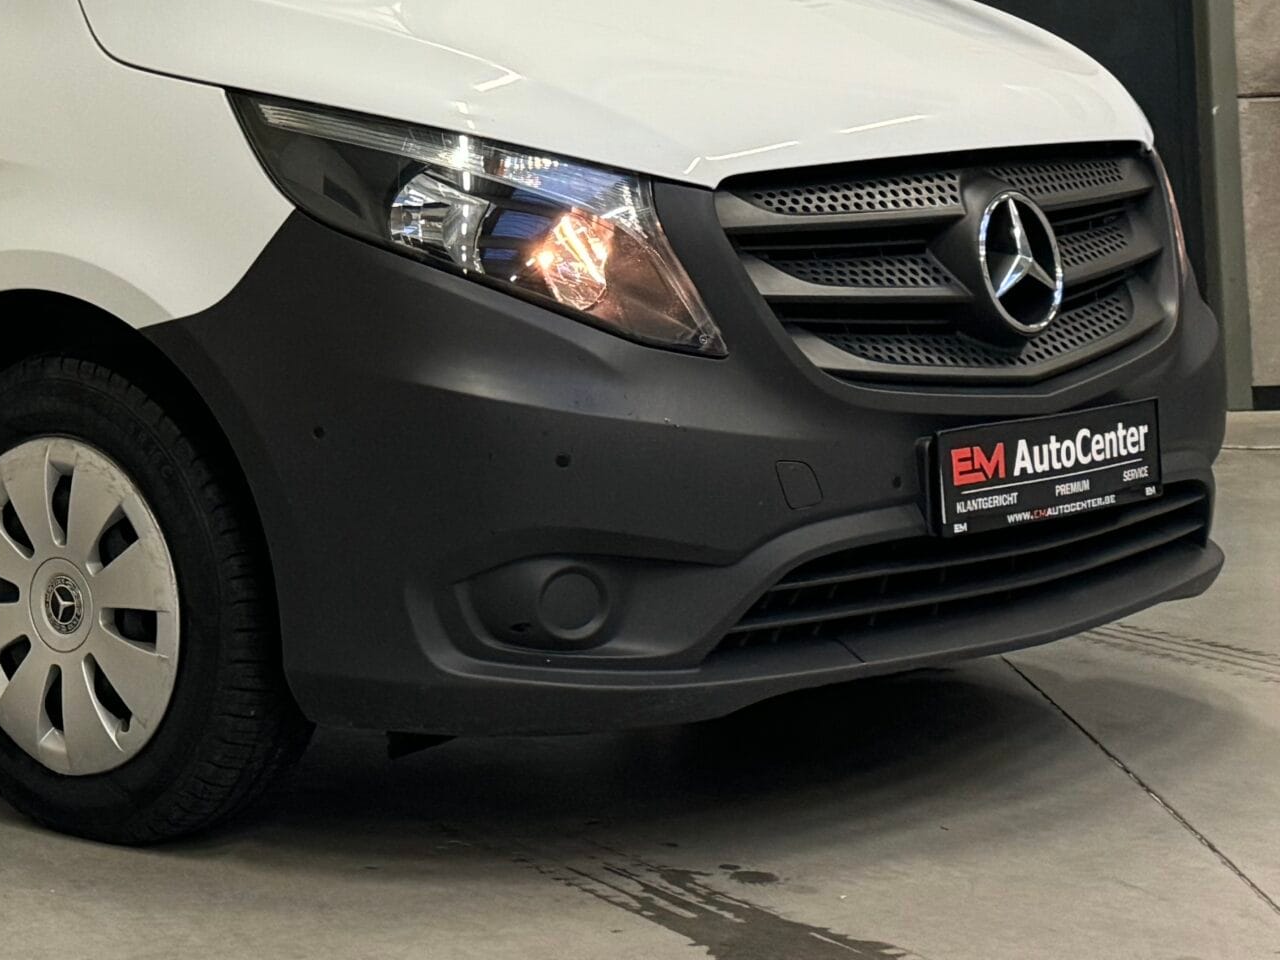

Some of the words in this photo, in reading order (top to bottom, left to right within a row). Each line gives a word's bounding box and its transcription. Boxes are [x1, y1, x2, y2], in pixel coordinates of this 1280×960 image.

[951, 442, 1006, 486] EM
[1013, 422, 1149, 477] AutoCenter
[956, 492, 1018, 514] KLANTGERICHT
[1055, 479, 1090, 497] PREMIUM
[1122, 466, 1149, 482] SERVICE
